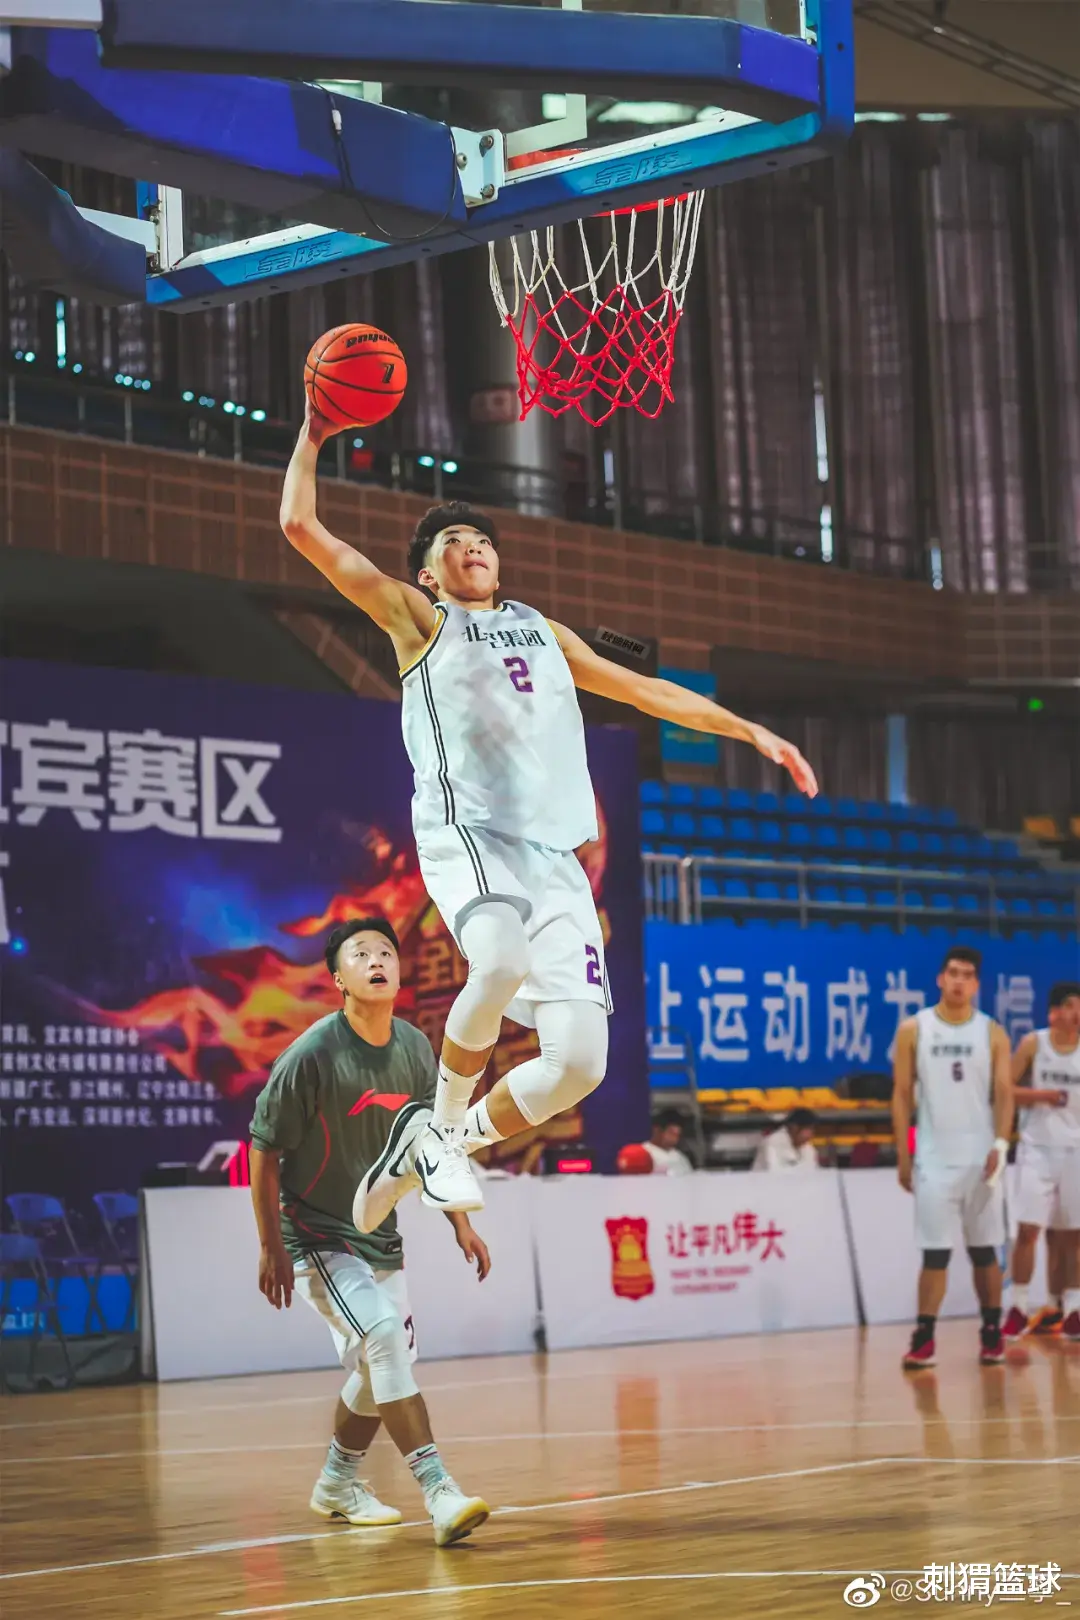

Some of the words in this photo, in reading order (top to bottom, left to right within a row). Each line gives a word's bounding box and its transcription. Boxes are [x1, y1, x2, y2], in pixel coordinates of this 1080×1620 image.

[381, 363, 395, 384] 7
[503, 657, 533, 692] 2
[0, 720, 282, 842] 宾赛区
[585, 944, 602, 987] 2
[666, 1209, 785, 1261] 让平凡伟大
